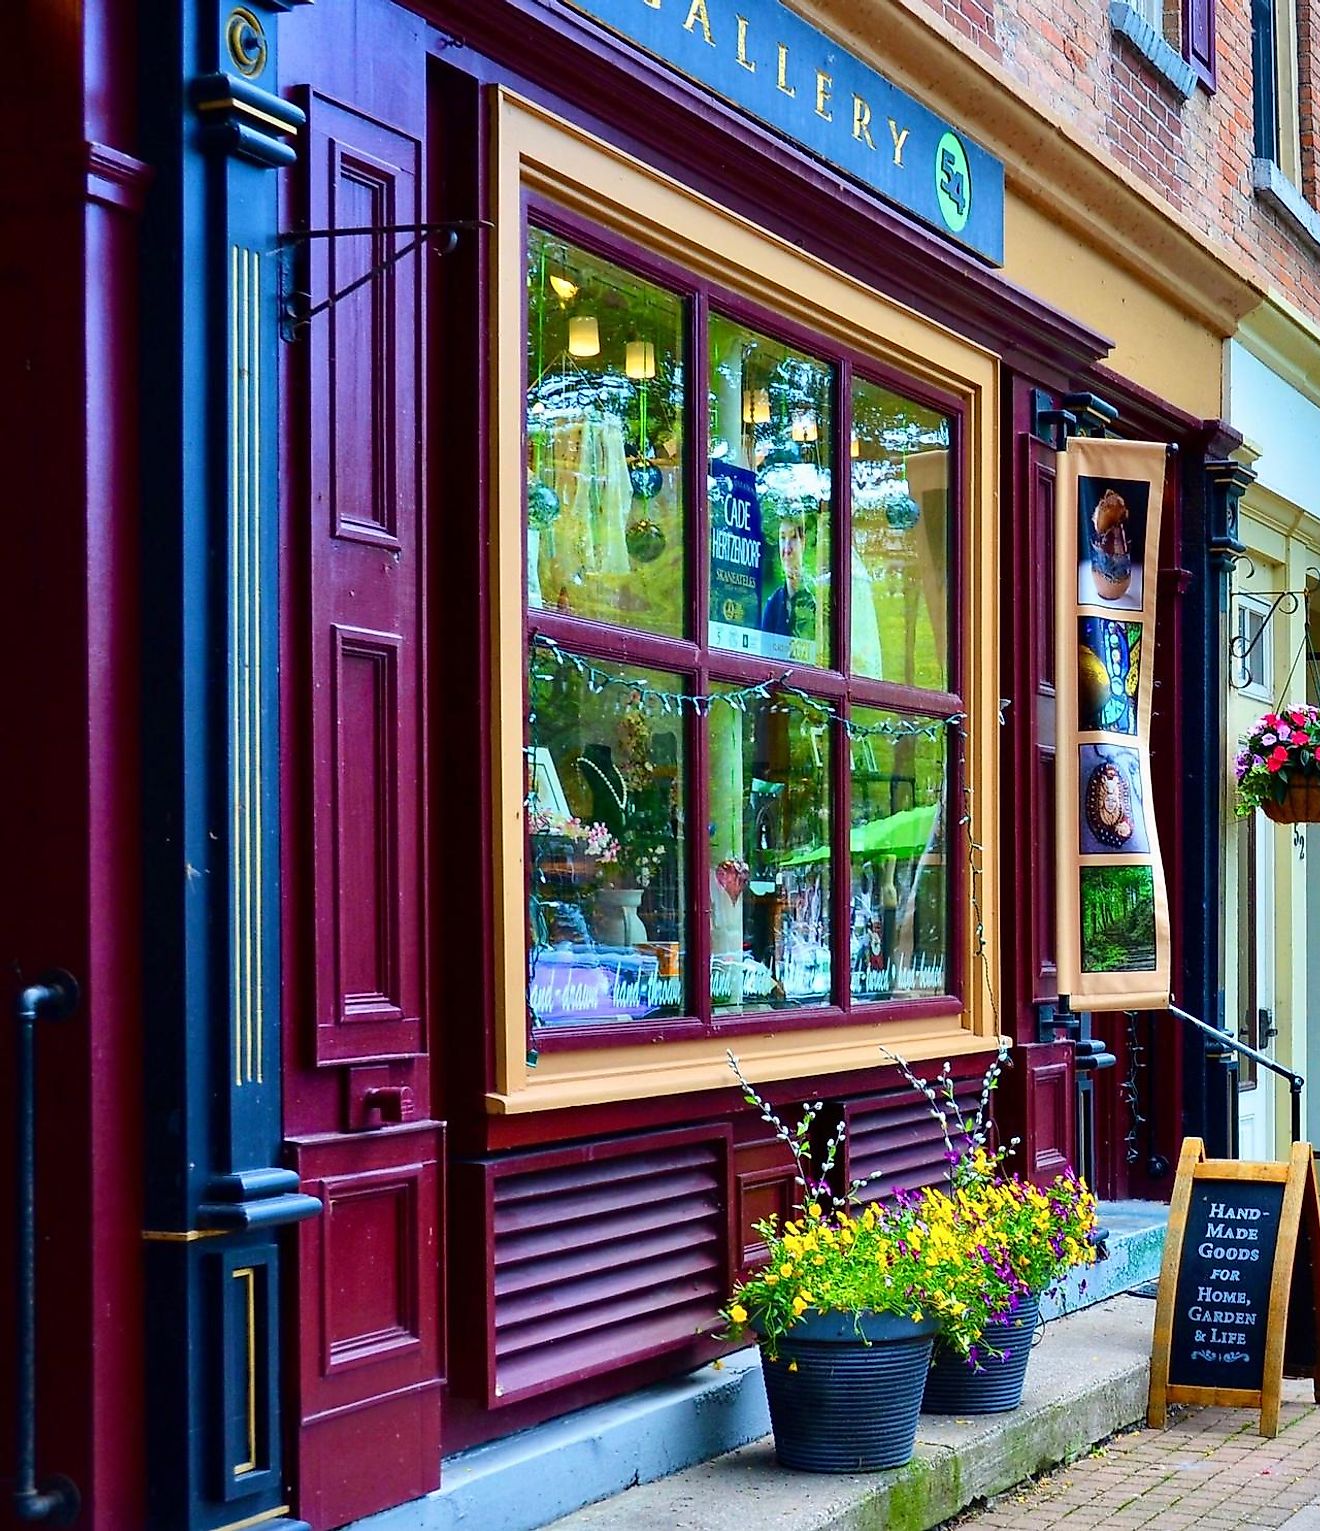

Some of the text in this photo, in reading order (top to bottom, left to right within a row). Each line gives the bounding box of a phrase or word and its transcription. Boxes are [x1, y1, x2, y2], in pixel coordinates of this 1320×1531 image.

[644, 0, 966, 215] ALLERY 54
[724, 493, 751, 531] CADE
[1294, 822, 1304, 859] 52
[1194, 1330, 1206, 1343] &
